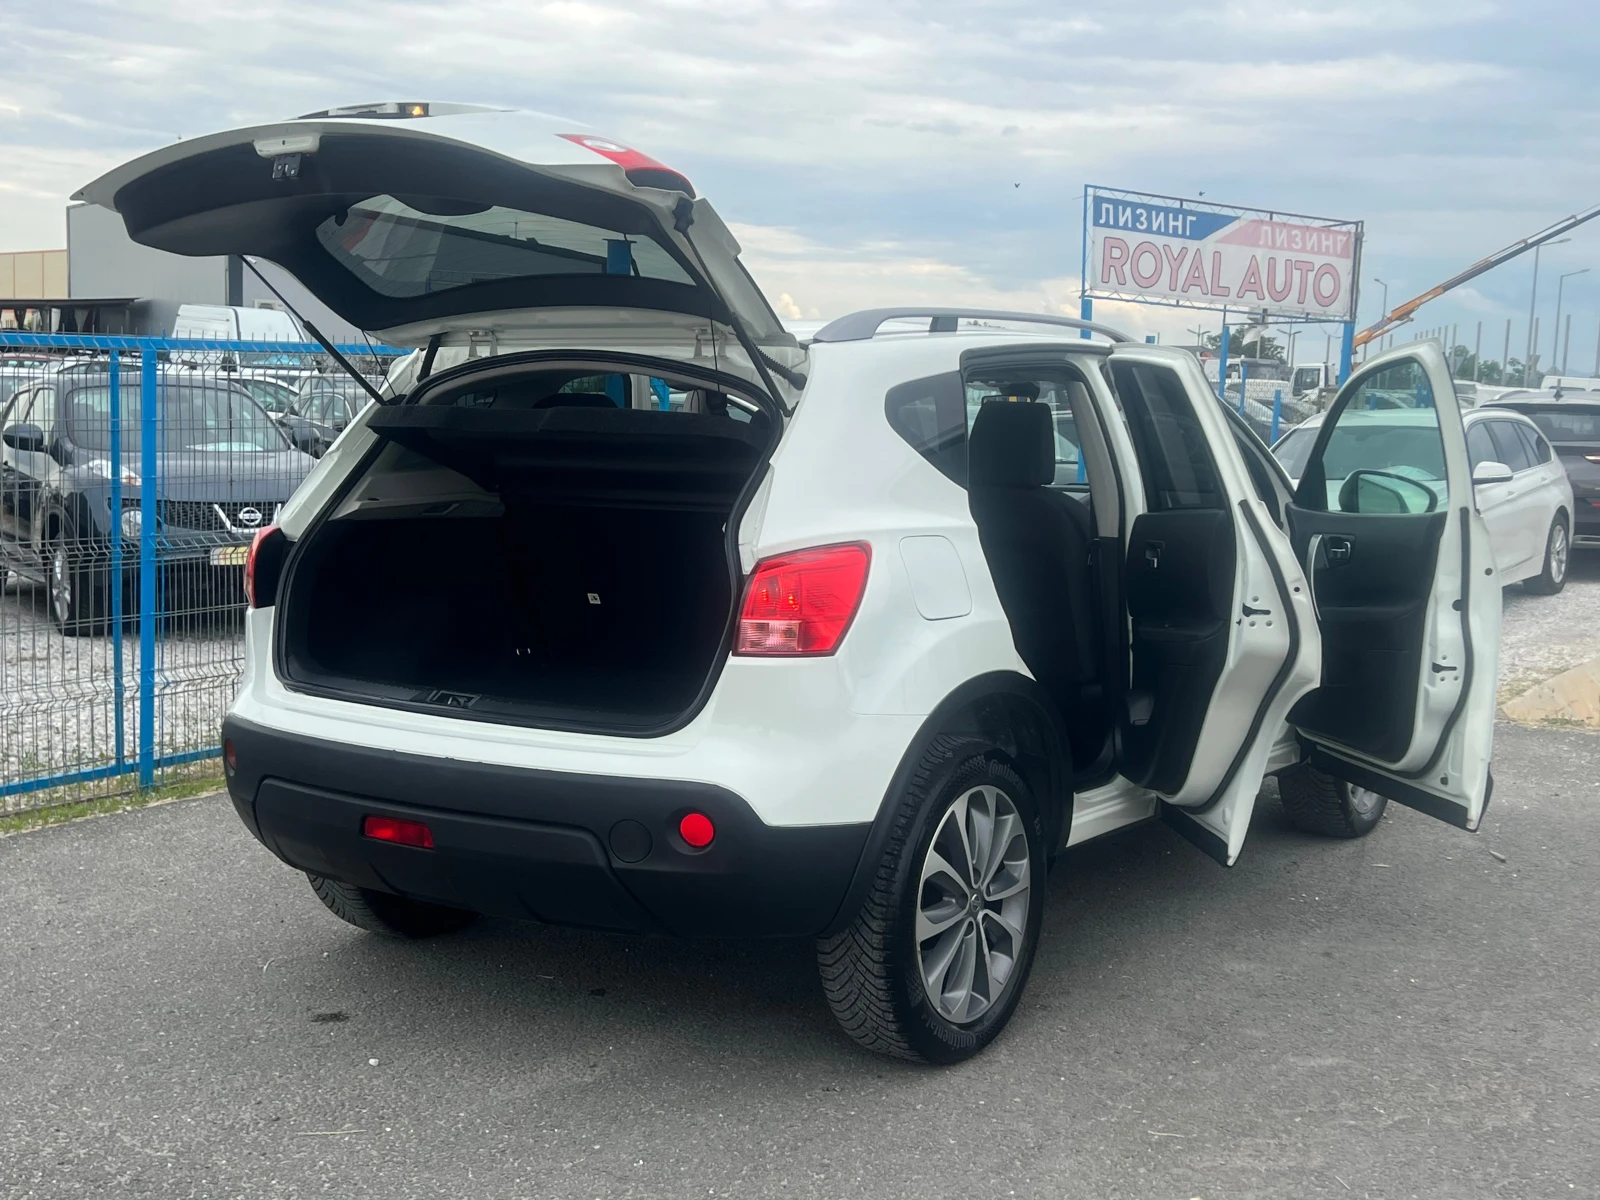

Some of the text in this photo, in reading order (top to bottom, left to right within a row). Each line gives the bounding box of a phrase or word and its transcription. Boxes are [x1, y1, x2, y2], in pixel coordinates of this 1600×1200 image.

[1099, 203, 1197, 236] ЛИЗИНГ
[1259, 225, 1349, 255] ЛИЗИНГ
[1101, 236, 1340, 308] ROYAL AUTO
[988, 758, 1028, 797] Continent
[924, 1015, 977, 1050] Continental
